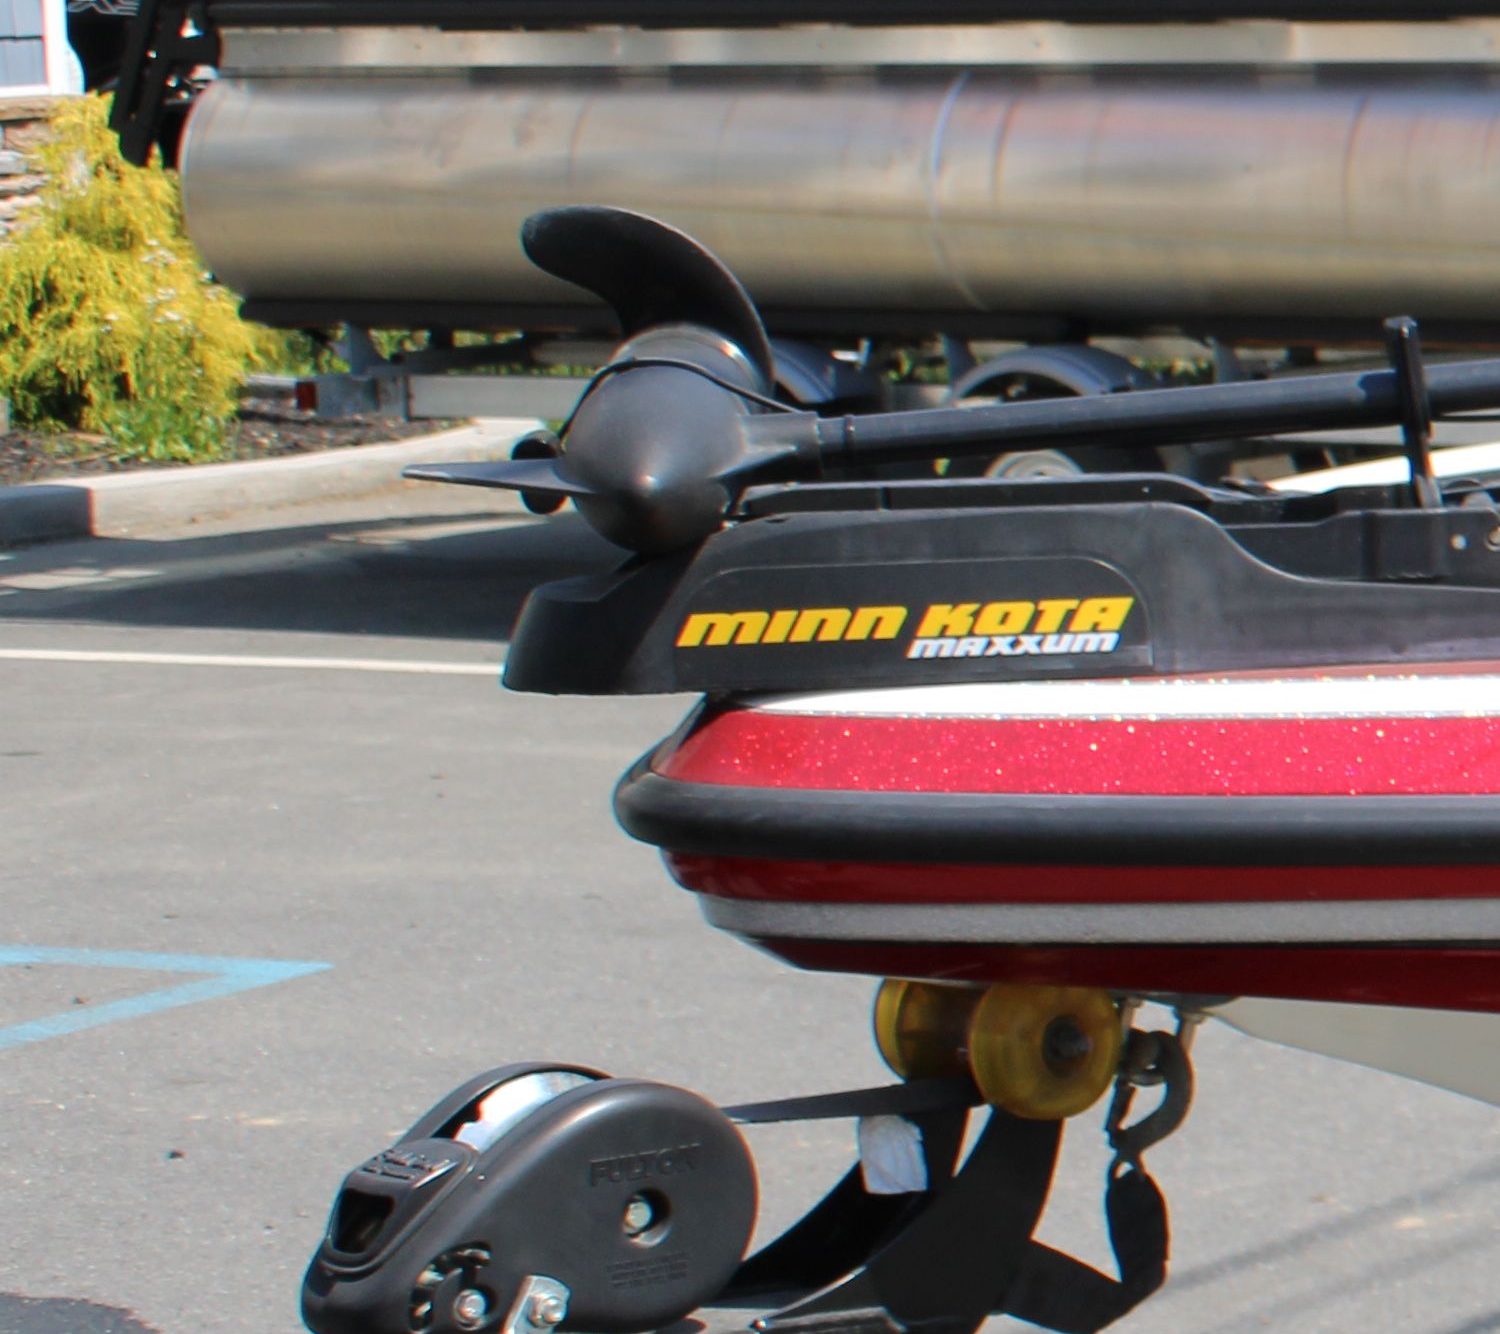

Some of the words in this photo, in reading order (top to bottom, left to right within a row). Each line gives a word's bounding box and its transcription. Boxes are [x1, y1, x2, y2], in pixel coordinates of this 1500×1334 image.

[915, 597, 1134, 638] KOTA
[906, 631, 1121, 659] MAXXUM
[590, 1142, 701, 1187] FULTON
